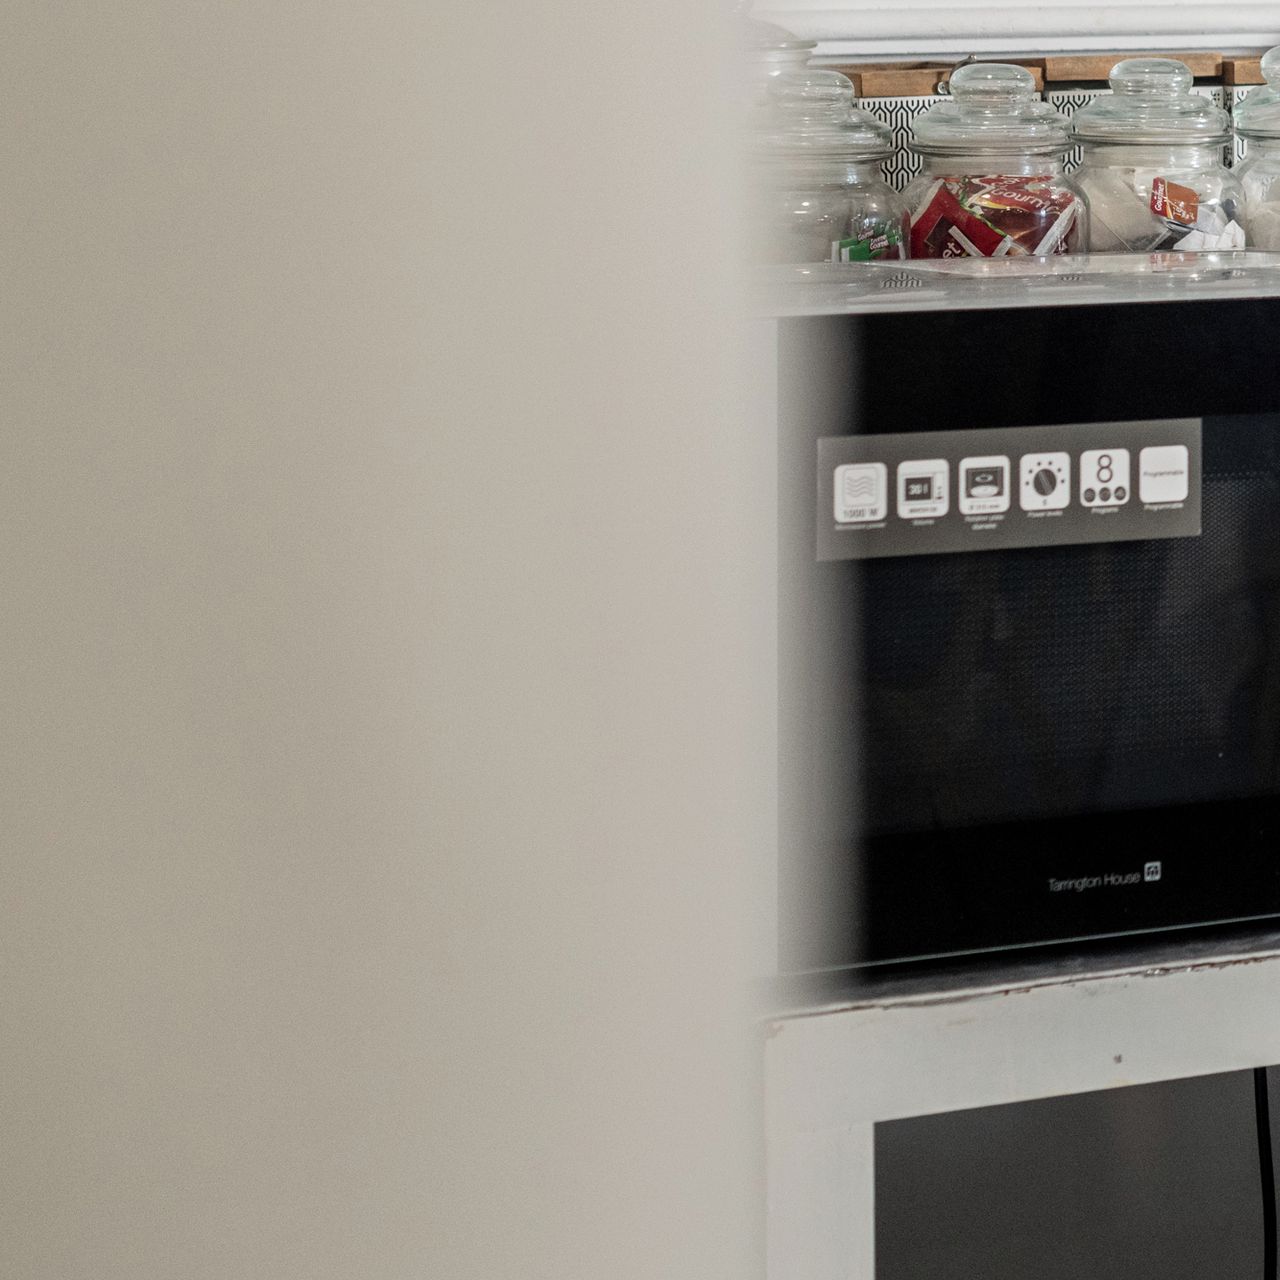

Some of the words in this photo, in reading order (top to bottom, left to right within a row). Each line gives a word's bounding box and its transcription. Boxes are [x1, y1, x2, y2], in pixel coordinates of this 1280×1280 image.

[1097, 454, 1113, 483] 8
[1049, 876, 1101, 892] Tarrington
[1103, 872, 1141, 886] House
